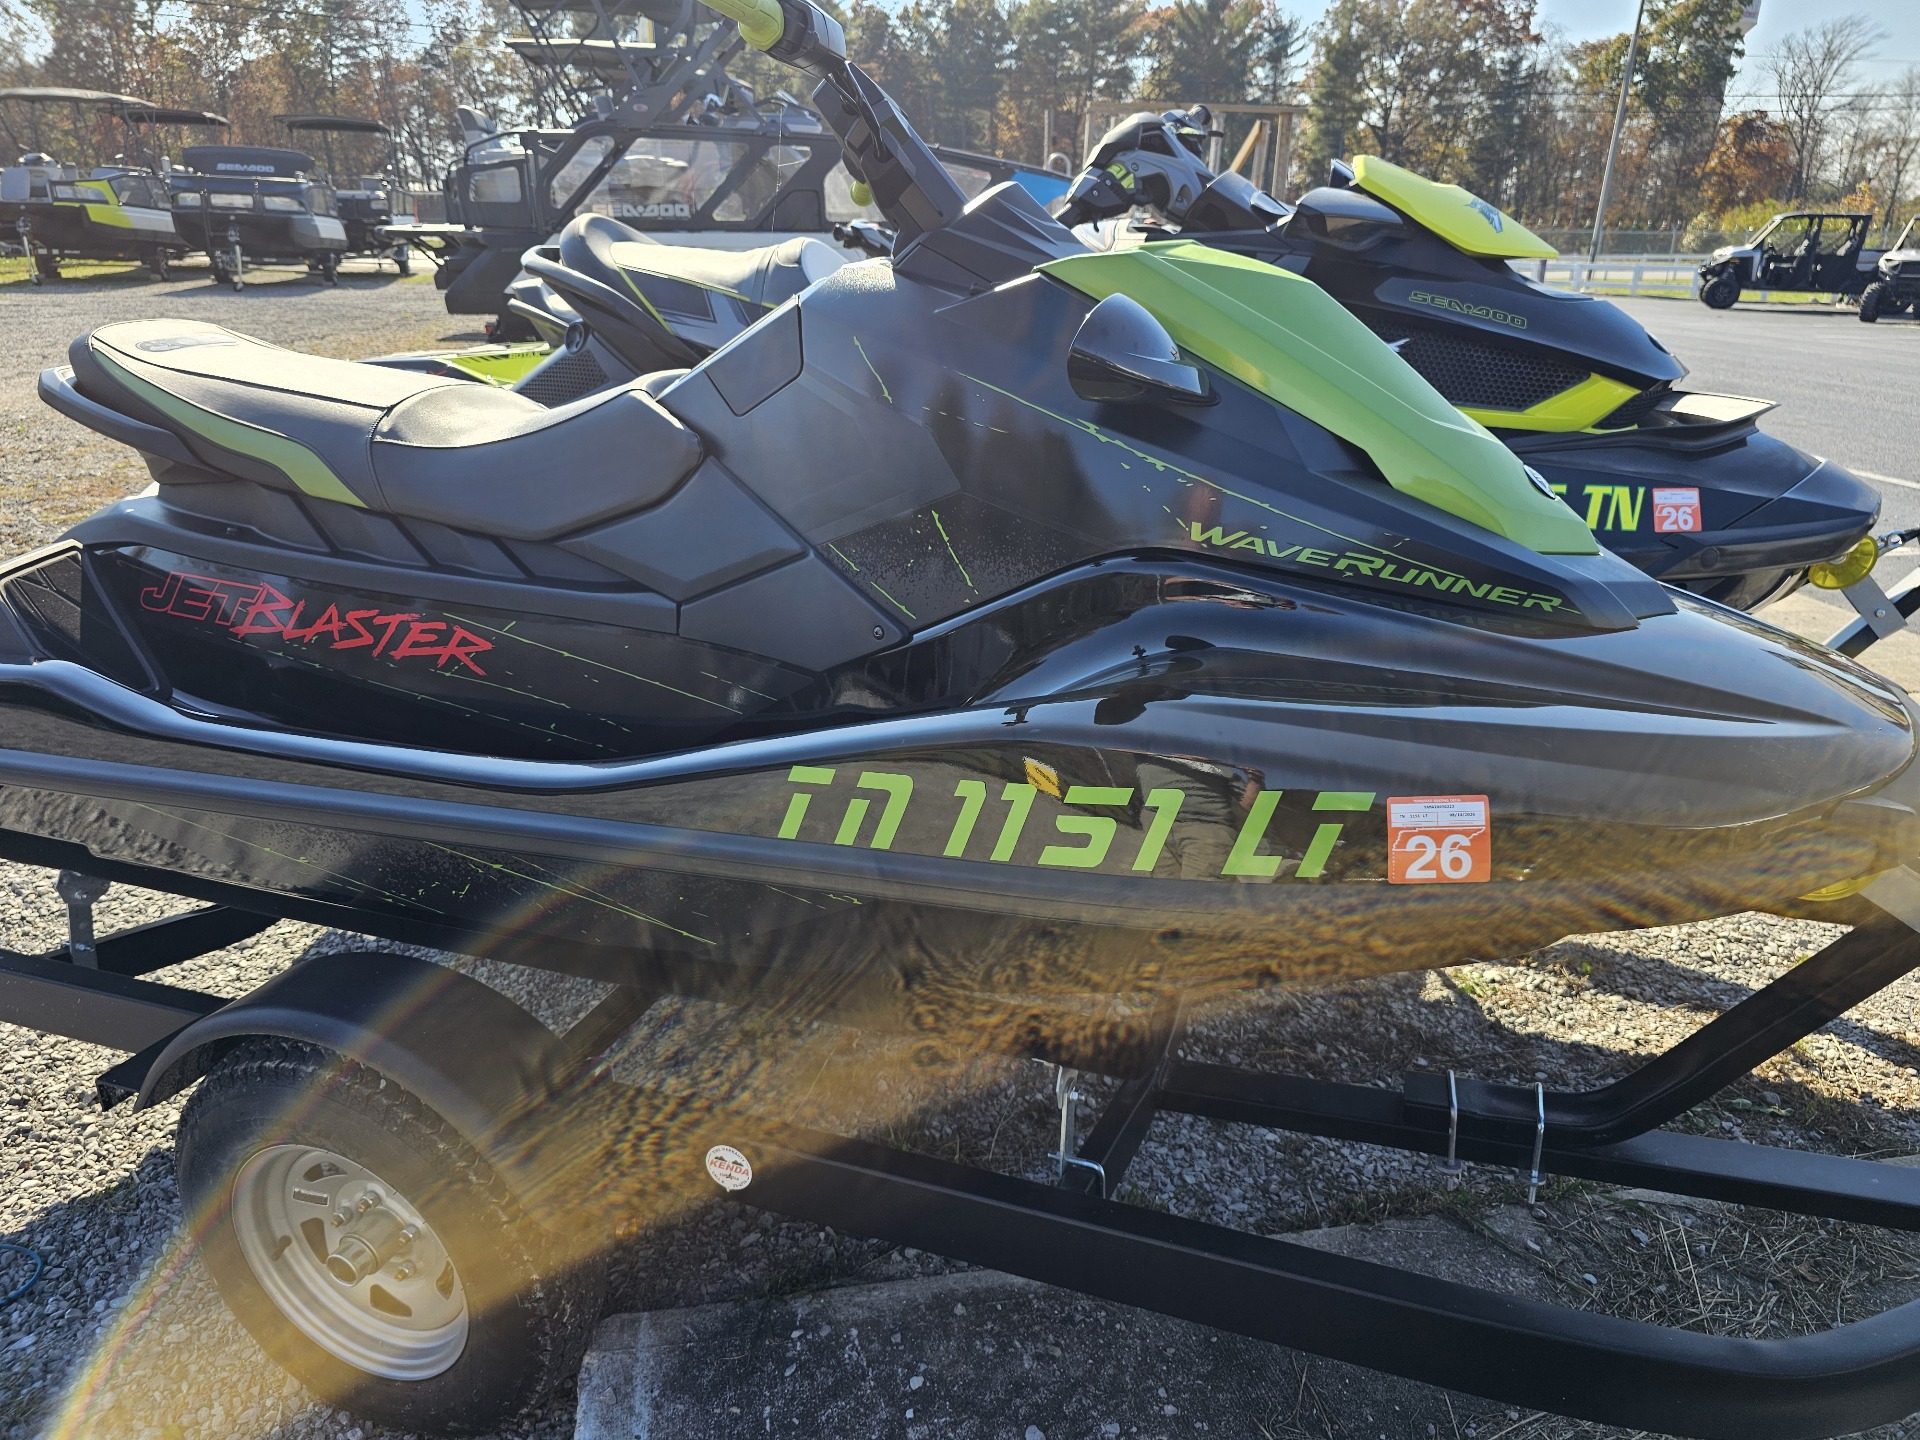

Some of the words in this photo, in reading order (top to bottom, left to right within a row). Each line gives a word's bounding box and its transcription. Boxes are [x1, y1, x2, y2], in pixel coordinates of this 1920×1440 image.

[1582, 484, 1646, 531] TN
[1661, 506, 1694, 531] 26
[1189, 522, 1562, 613] WAVERUNNER
[777, 765, 915, 850] TN
[943, 779, 1186, 872] 1151
[1220, 791, 1376, 878] LT
[1405, 833, 1473, 880] 26
[709, 1158, 750, 1177] KENDA
